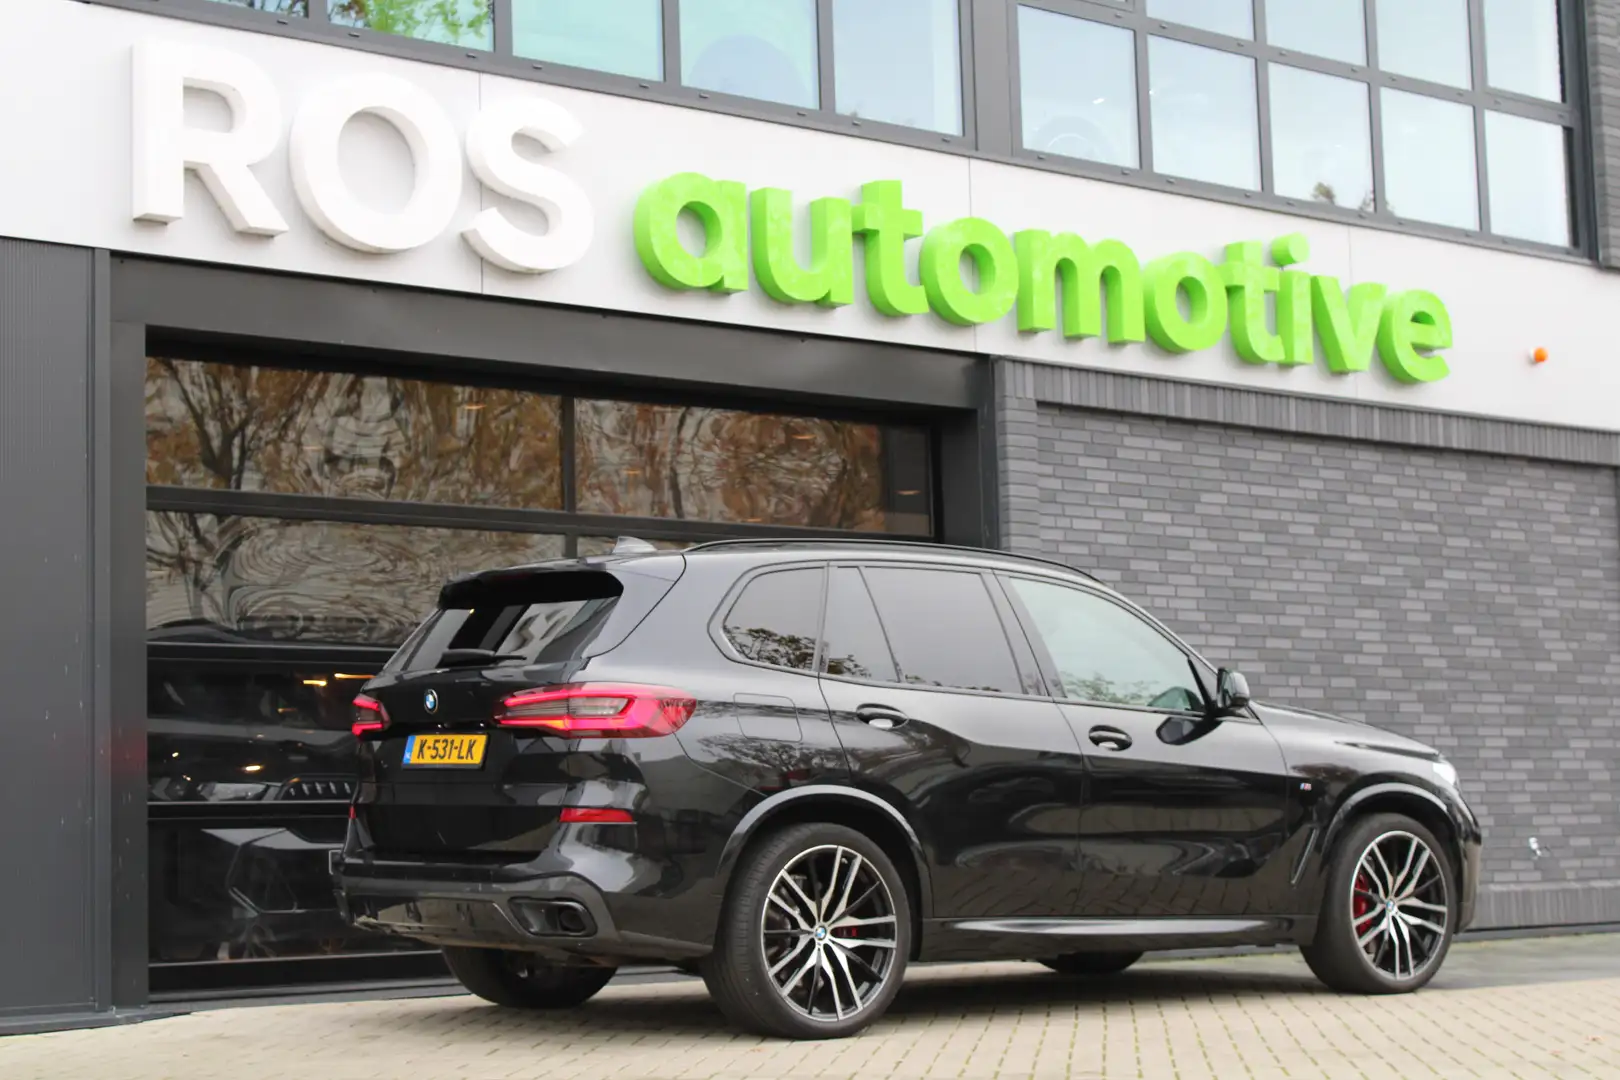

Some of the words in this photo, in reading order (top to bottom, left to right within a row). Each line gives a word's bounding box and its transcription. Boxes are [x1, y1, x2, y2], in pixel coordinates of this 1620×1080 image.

[131, 42, 595, 274] ROS
[633, 172, 1453, 384] automotive
[417, 738, 477, 760] K-531-LK
